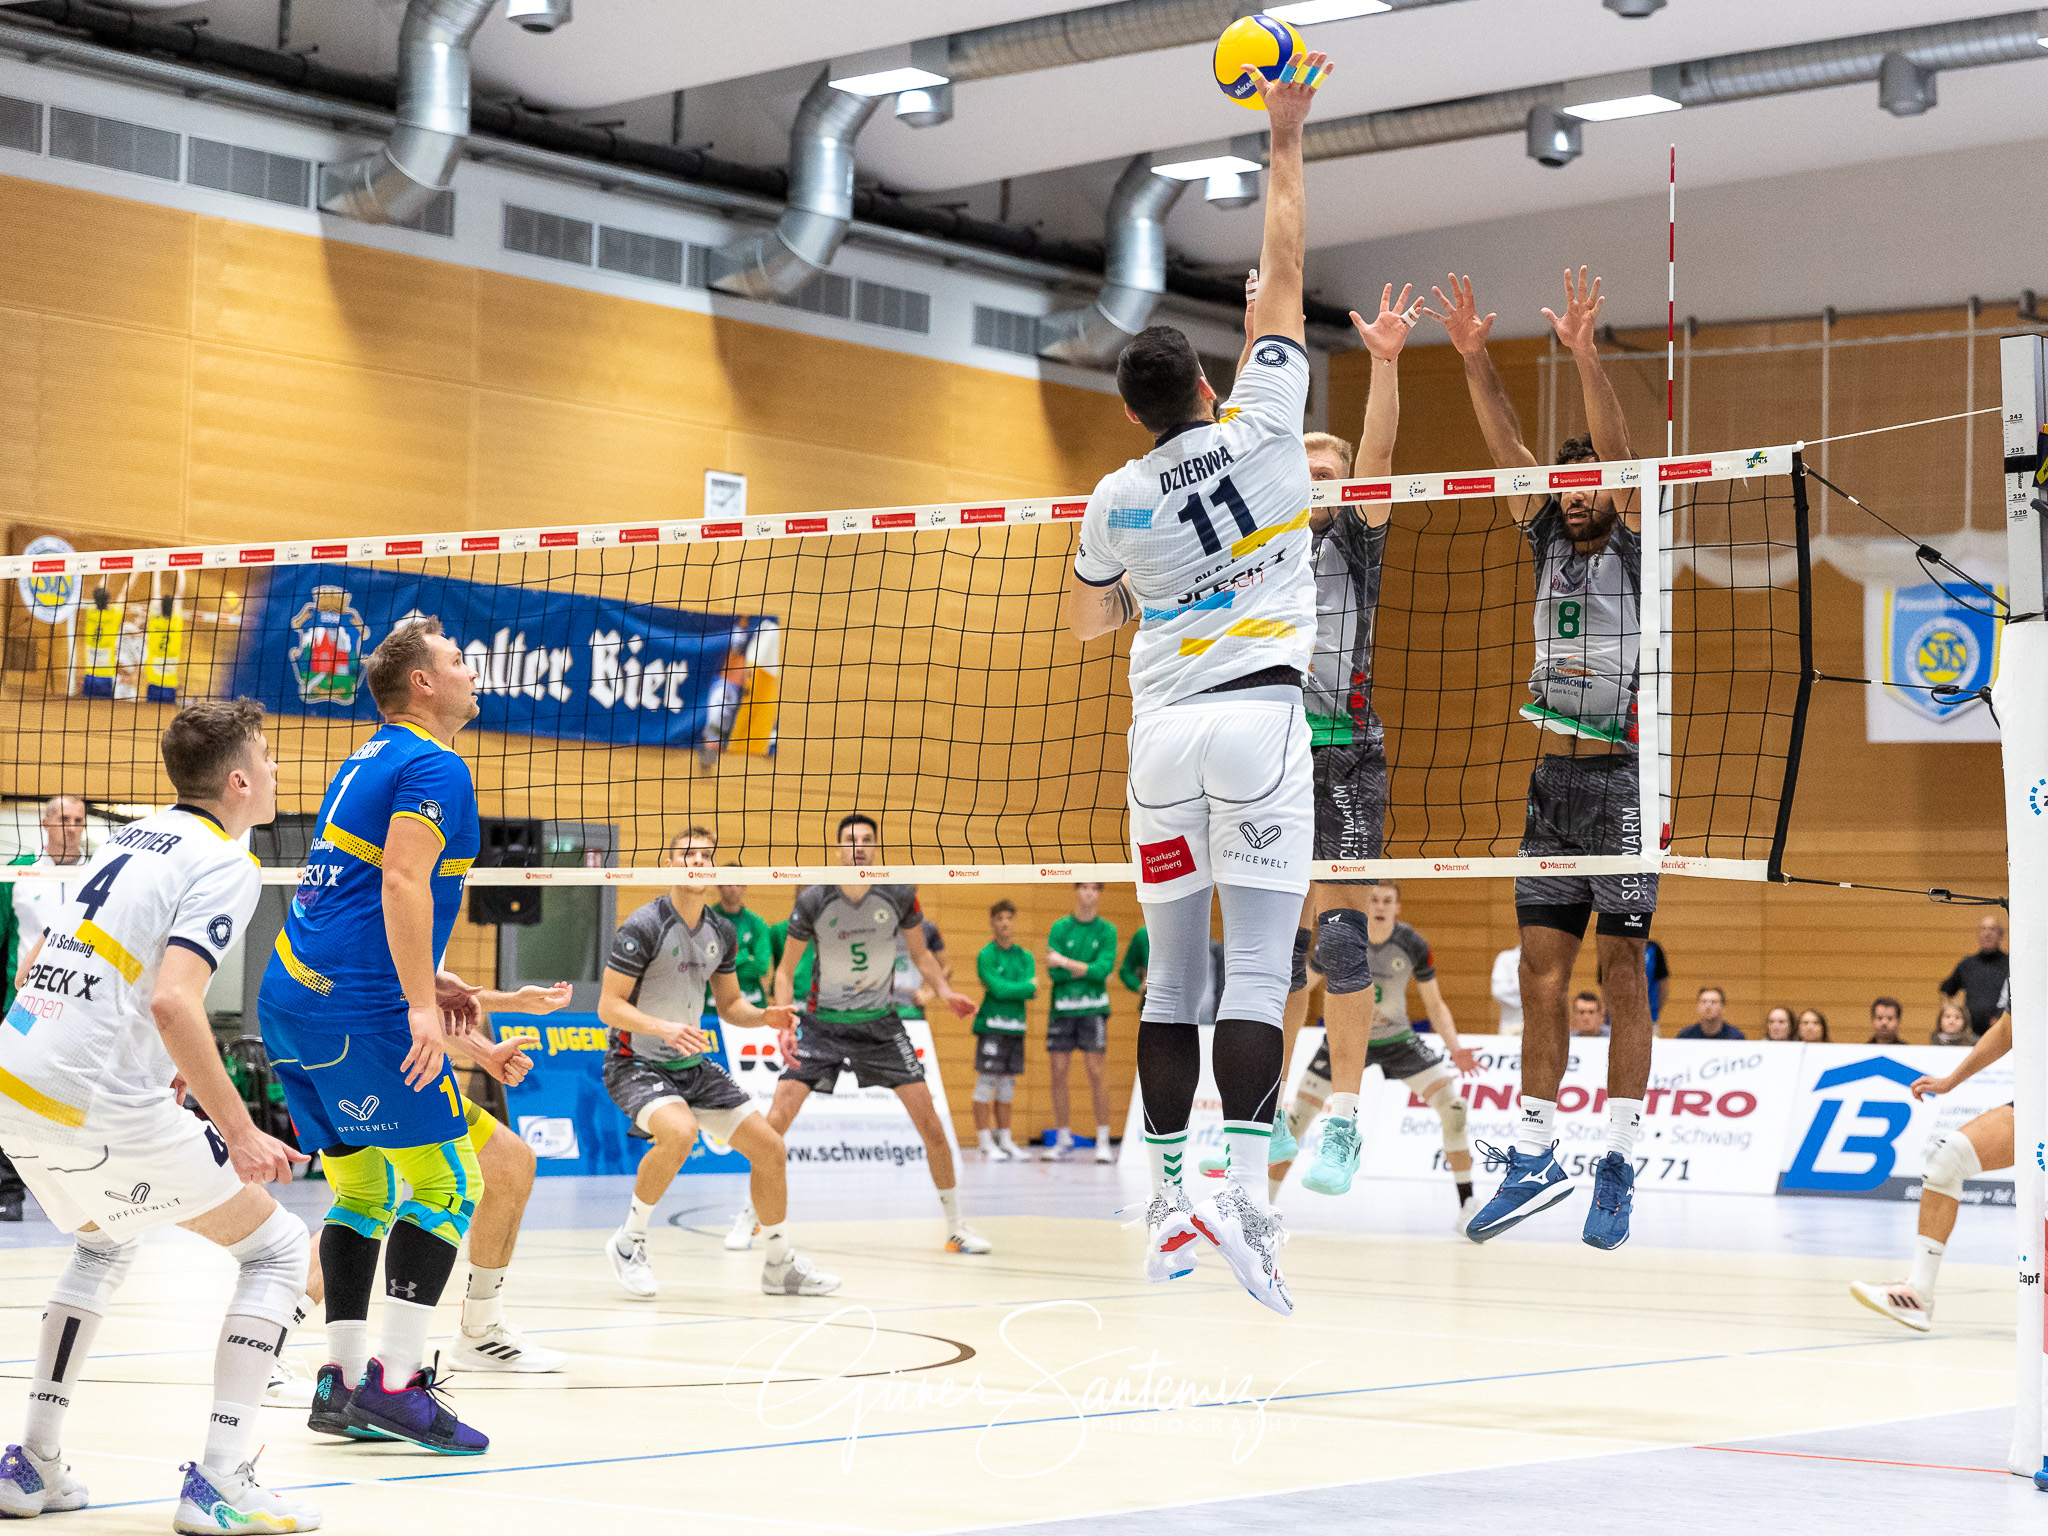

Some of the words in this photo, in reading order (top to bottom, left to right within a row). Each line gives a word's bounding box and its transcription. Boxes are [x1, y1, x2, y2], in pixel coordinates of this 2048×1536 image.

[1160, 446, 1234, 495] DZIERWA
[1178, 474, 1258, 556] 11
[1558, 601, 1581, 639] 8
[590, 629, 689, 714] Bier
[325, 765, 361, 823] 1
[1145, 849, 1180, 864] Sparkasse
[1149, 858, 1182, 874] Nürnberg
[1223, 850, 1289, 870] OFFICEWELT
[76, 853, 133, 921] 4
[57, 934, 95, 958] Schwaig
[851, 942, 867, 964] 5
[546, 1027, 609, 1056] JUGEN
[1700, 1054, 1763, 1080] Gino
[439, 1075, 460, 1117] 1
[338, 1121, 399, 1133] OFFICEWELT
[1660, 1158, 1690, 1180] 71
[108, 1196, 182, 1223] OFFICEWELT
[247, 1340, 273, 1352] cep
